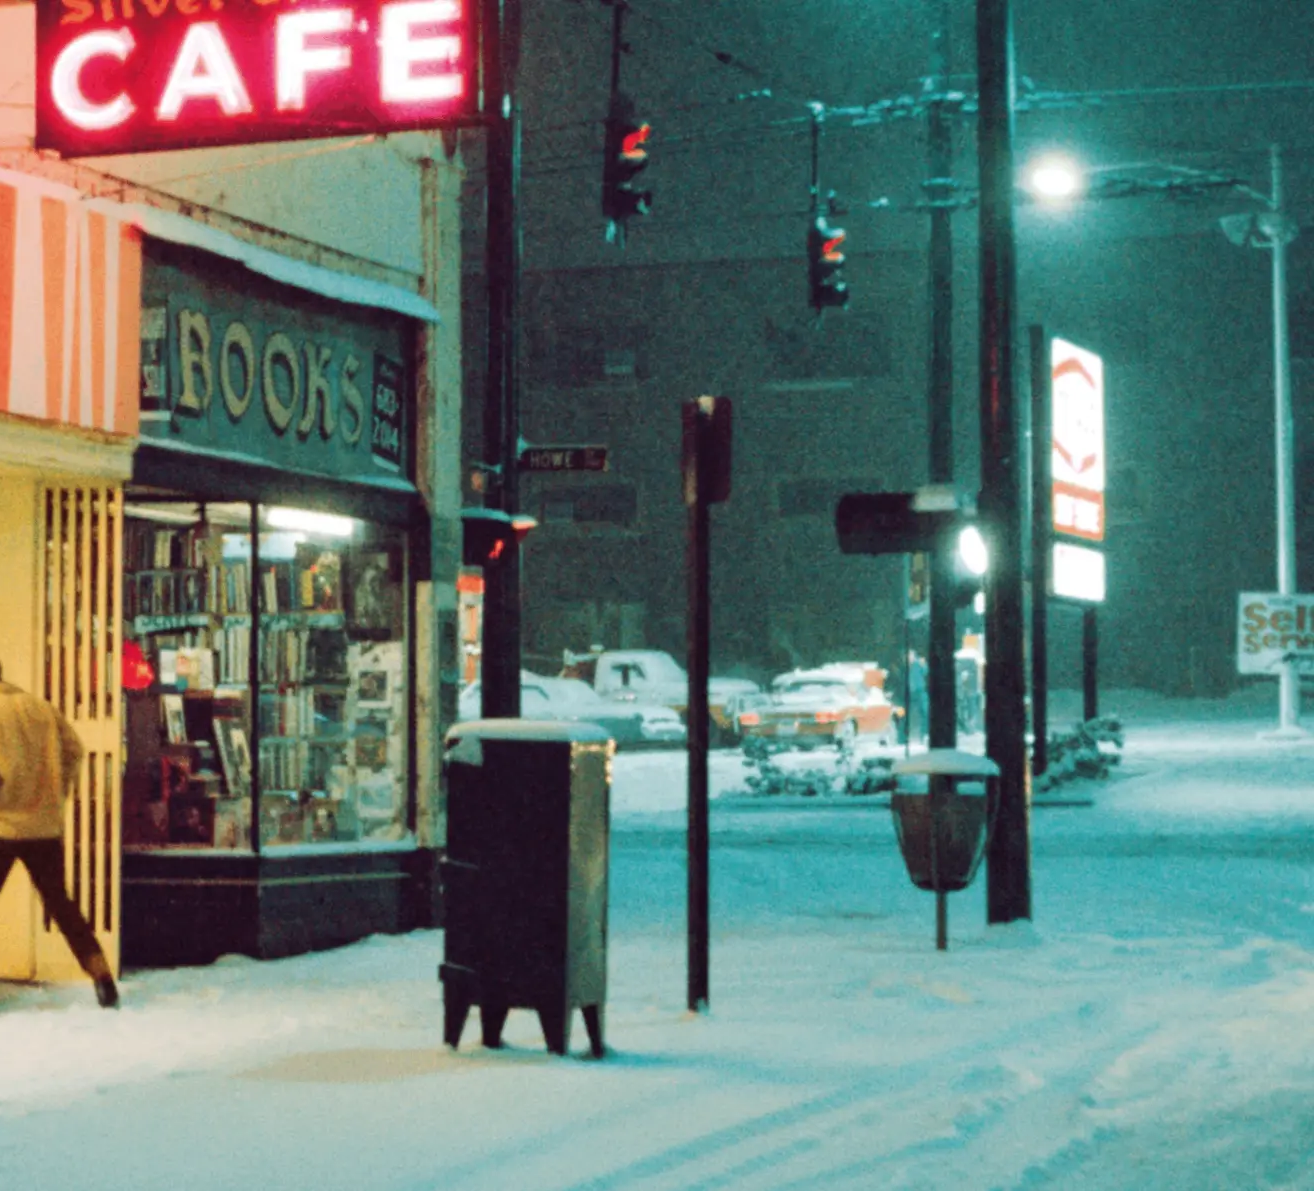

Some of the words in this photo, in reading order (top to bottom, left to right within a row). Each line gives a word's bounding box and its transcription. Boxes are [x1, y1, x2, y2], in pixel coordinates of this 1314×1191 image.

[49, 0, 465, 131] CAFE
[174, 308, 365, 446] BOOKS
[530, 451, 575, 469] HOWE
